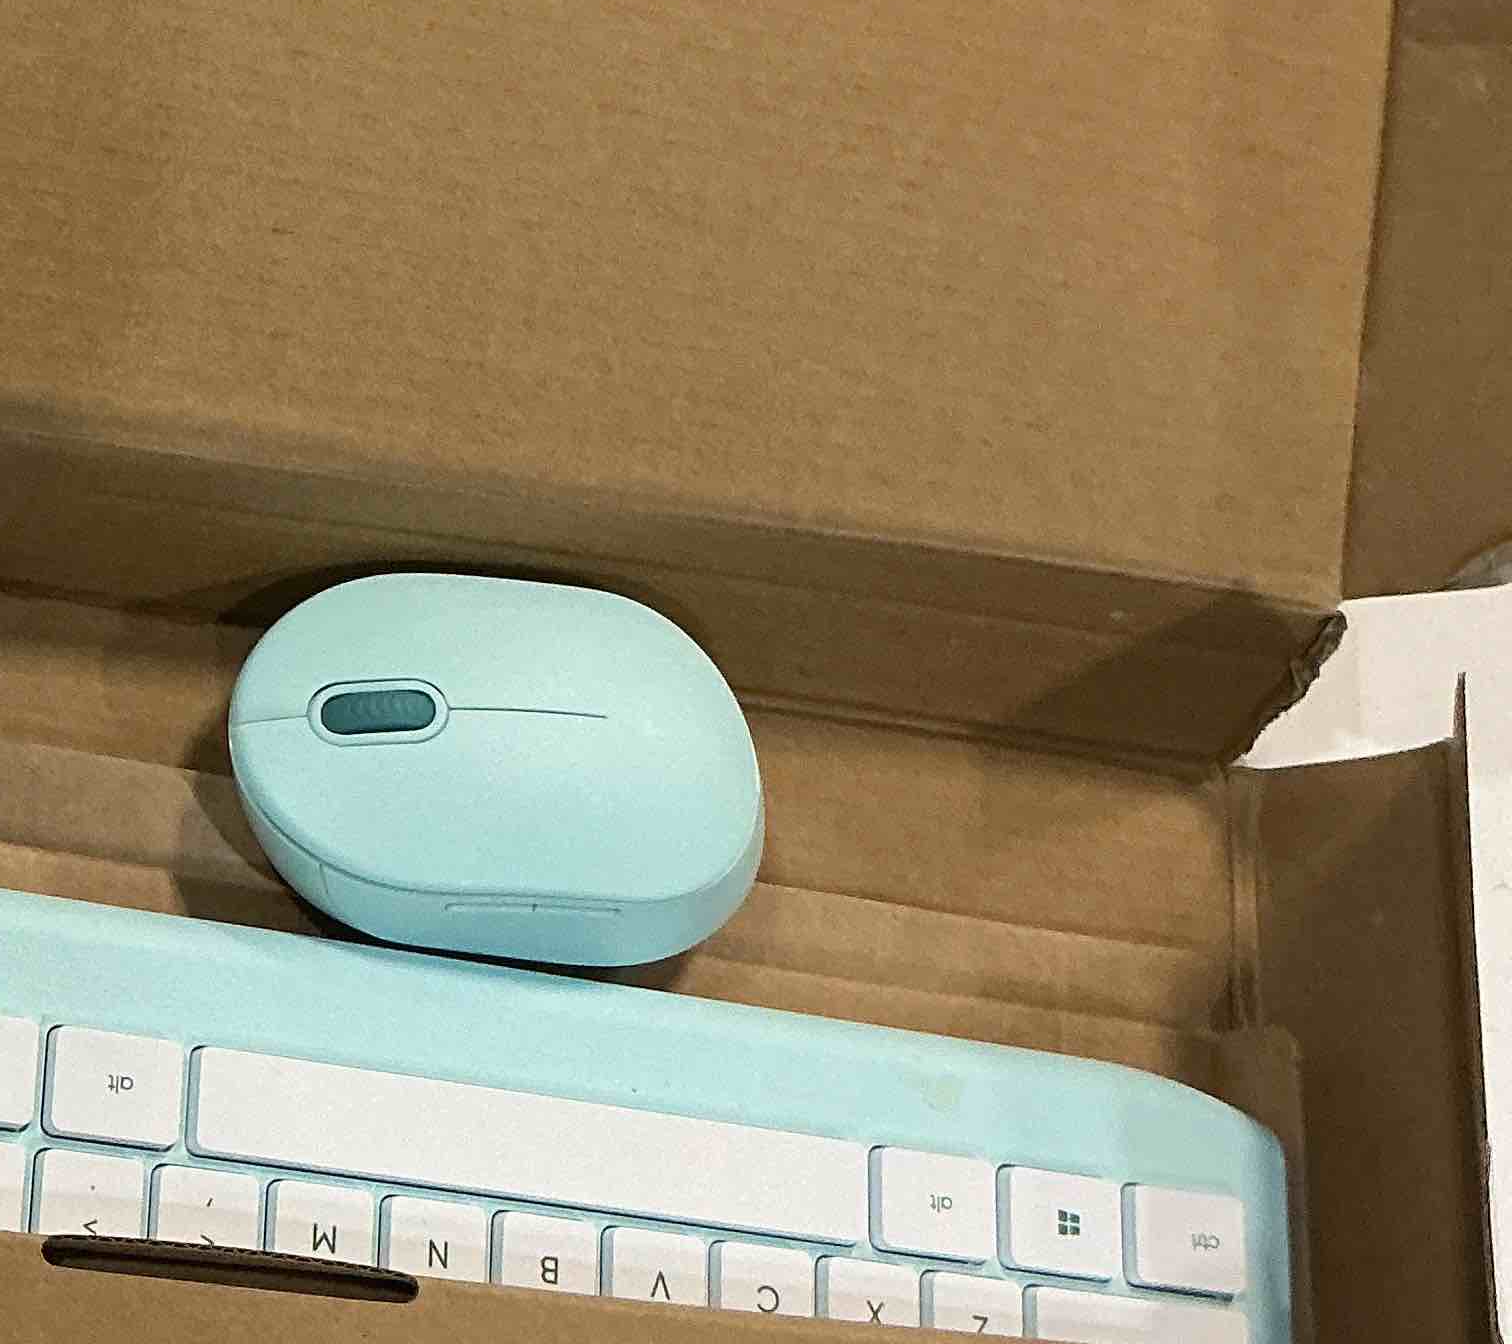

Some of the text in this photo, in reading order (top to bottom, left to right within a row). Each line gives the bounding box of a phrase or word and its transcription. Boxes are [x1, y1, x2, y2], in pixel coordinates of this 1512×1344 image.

[107, 1074, 134, 1094] alt
[930, 1194, 953, 1213] alt
[312, 1223, 337, 1254] M
[1191, 1233, 1221, 1251] ctrl
[428, 1239, 448, 1269] N
[540, 1255, 559, 1285] B
[650, 1271, 671, 1301] V
[756, 1285, 780, 1315] C
[865, 1299, 884, 1325] X
